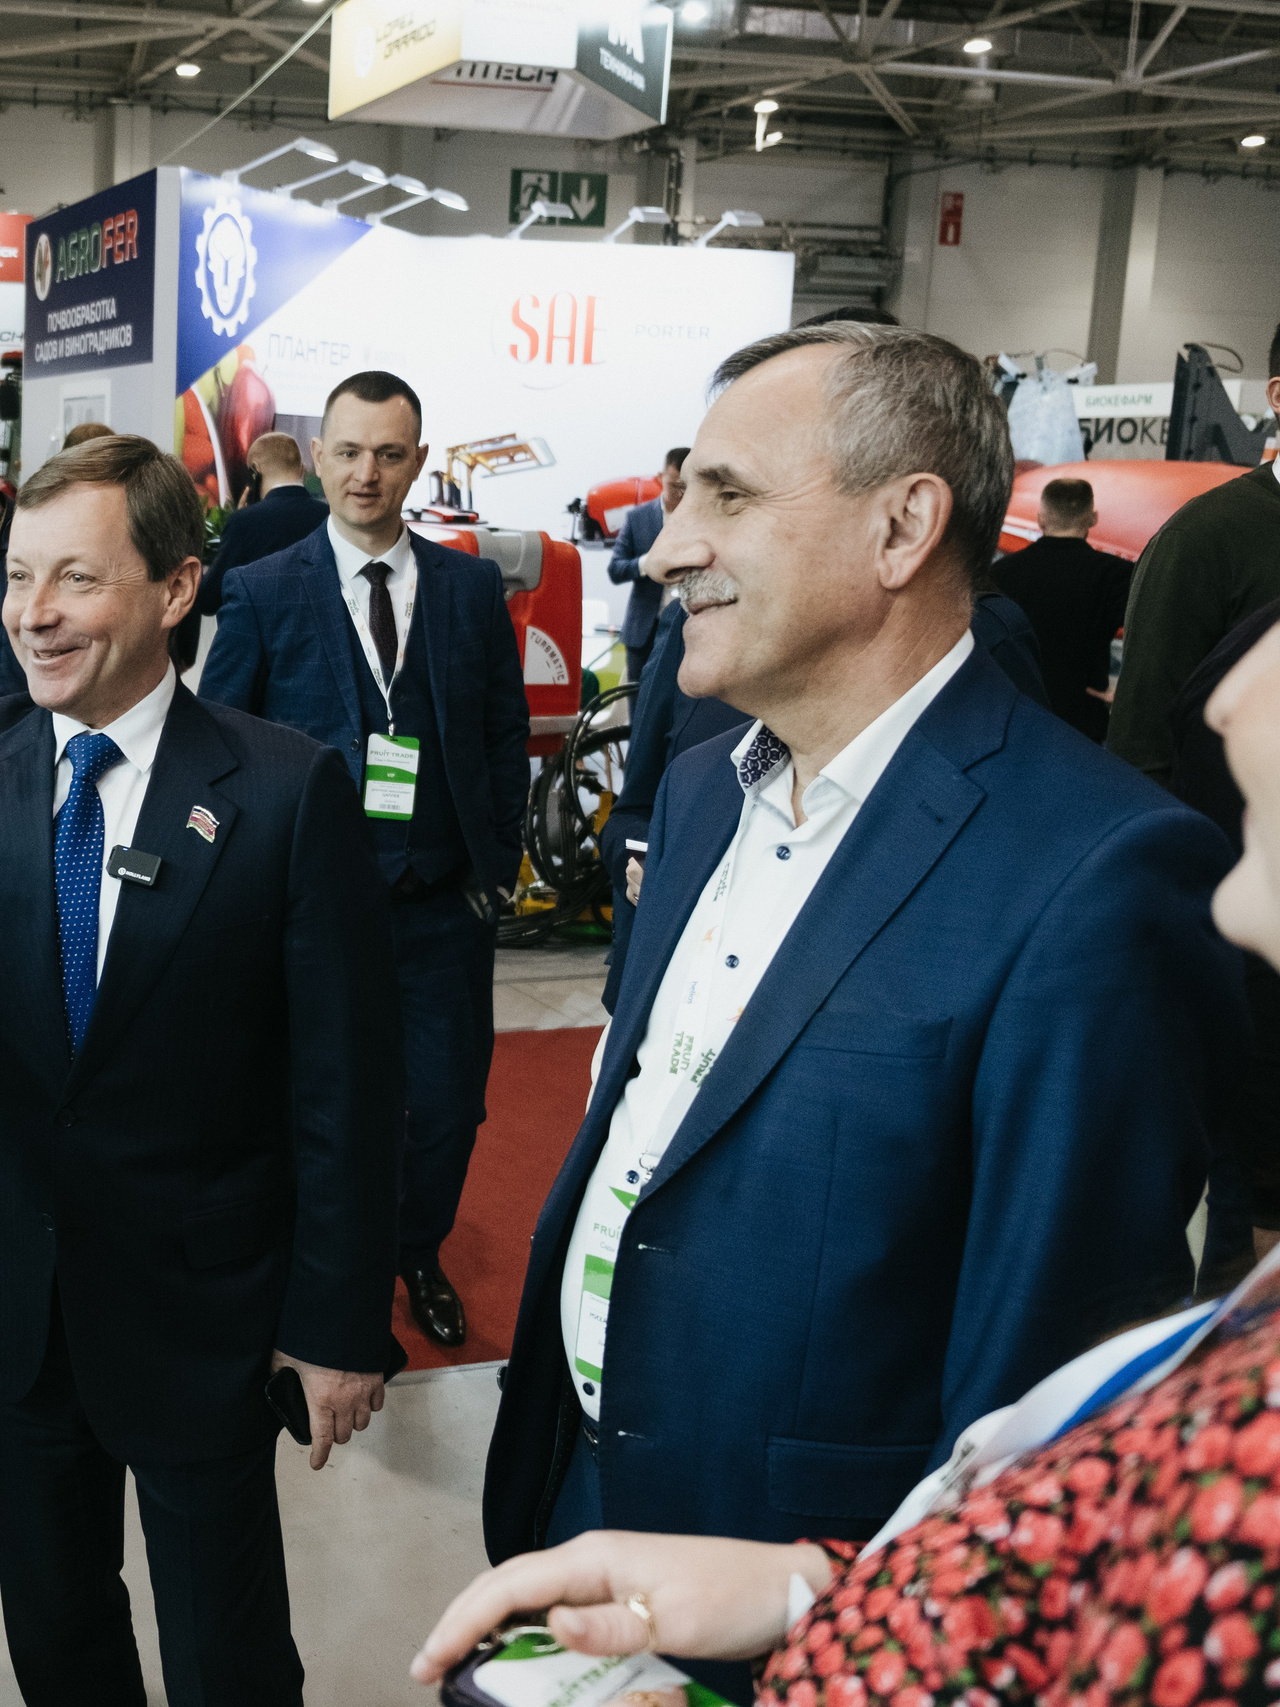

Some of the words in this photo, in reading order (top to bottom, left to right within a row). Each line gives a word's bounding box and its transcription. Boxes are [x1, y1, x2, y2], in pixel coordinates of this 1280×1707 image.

[56, 209, 138, 283] AGROFER
[47, 297, 117, 333] ПОЧВООБРАБОТКА
[509, 290, 607, 365] SAE
[634, 323, 711, 340] PORTER
[34, 339, 58, 364] САДОВ
[59, 338, 64, 358] И
[65, 323, 133, 358] ВИНОГРАДНИКОВ
[268, 333, 351, 366] ПЛАНТЕР
